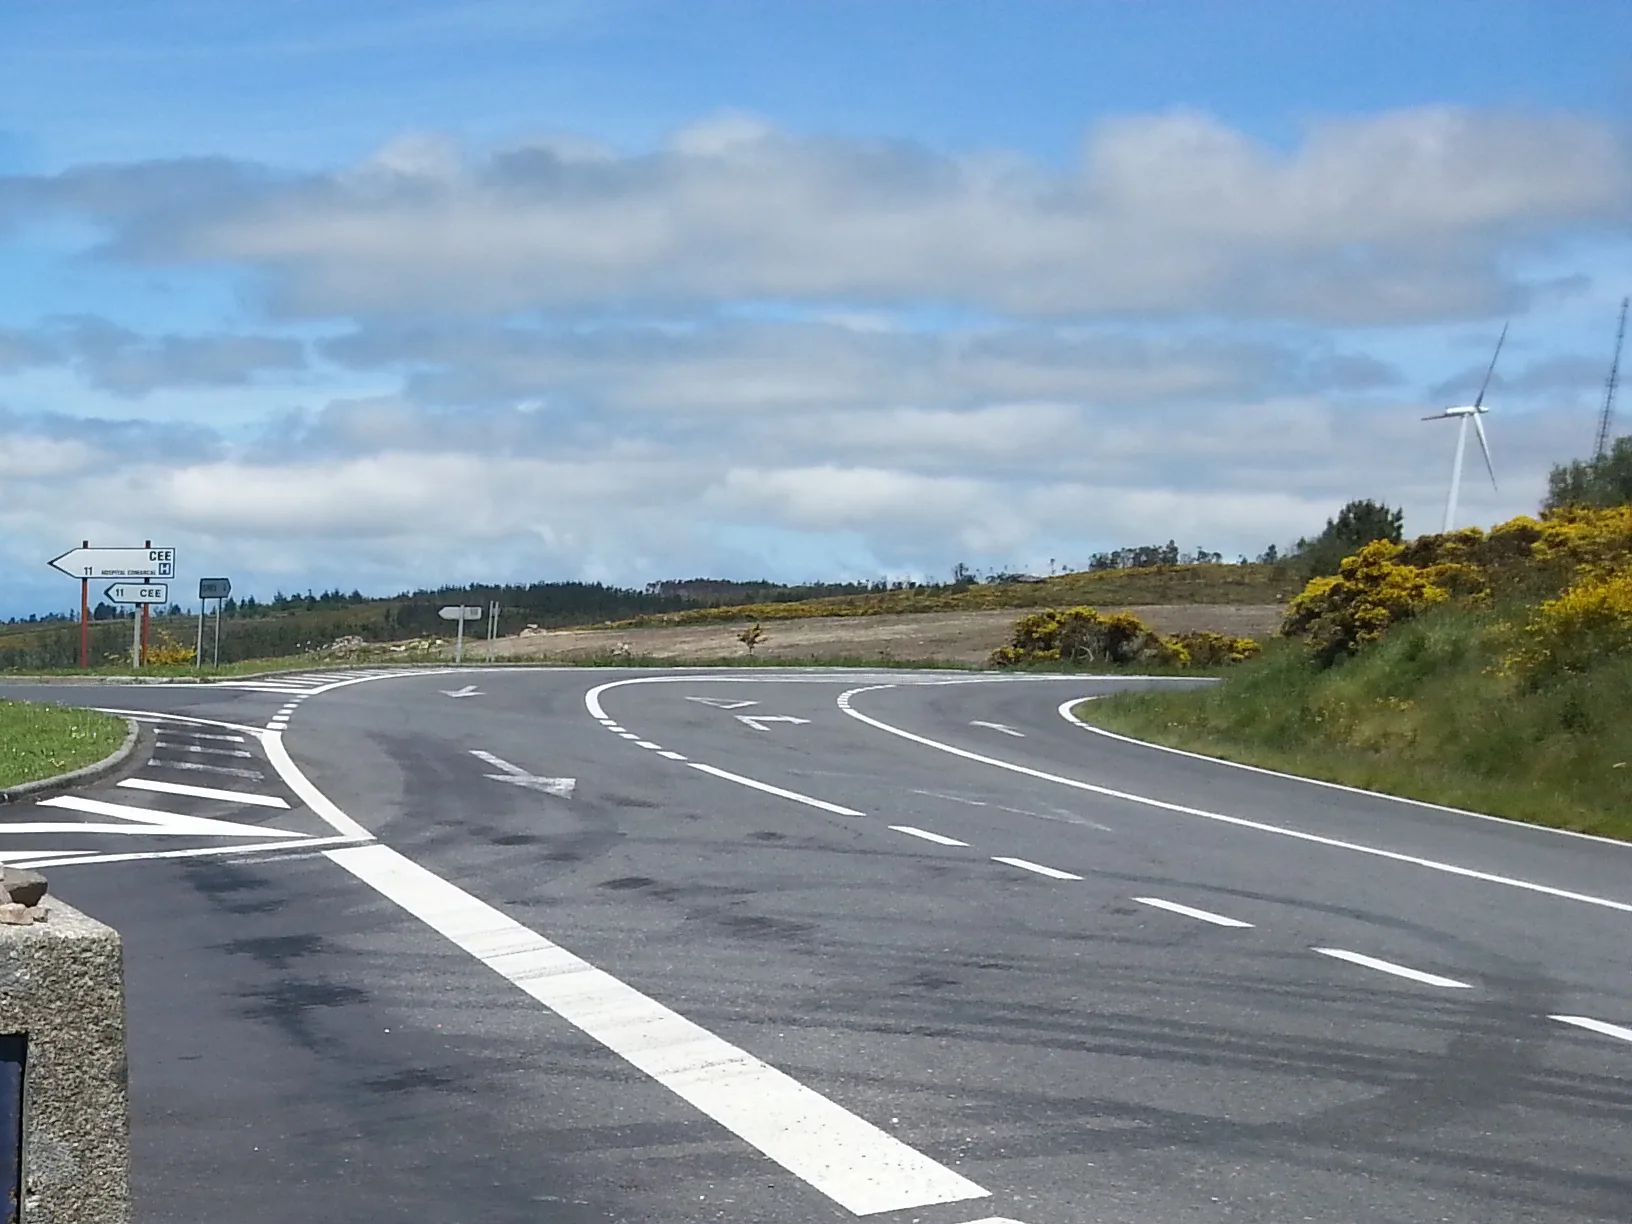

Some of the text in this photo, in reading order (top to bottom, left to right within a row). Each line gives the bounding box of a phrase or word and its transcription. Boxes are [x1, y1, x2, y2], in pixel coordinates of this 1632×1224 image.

[149, 551, 171, 561] CEE
[84, 567, 92, 575] 11
[115, 589, 161, 598] 11 CEE
